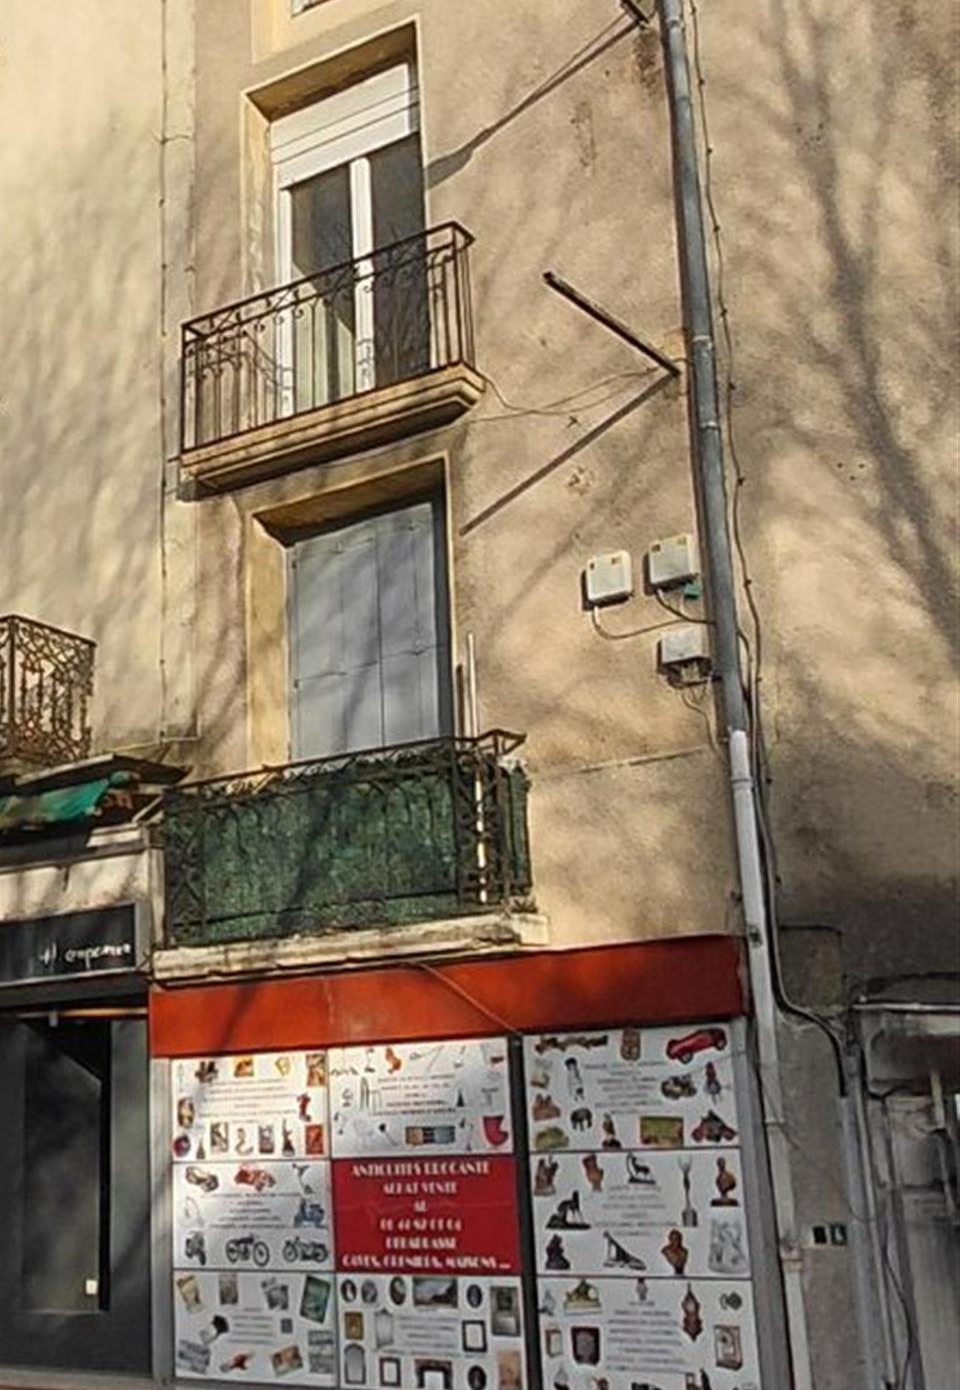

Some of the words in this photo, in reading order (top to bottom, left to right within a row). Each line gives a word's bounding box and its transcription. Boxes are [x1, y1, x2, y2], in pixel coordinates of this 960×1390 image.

[424, 1161, 490, 1175] BROCANTE
[383, 1182, 419, 1194] ACHAT
[421, 1181, 457, 1193] VENTE
[386, 1237, 457, 1249] DEBARRASSE
